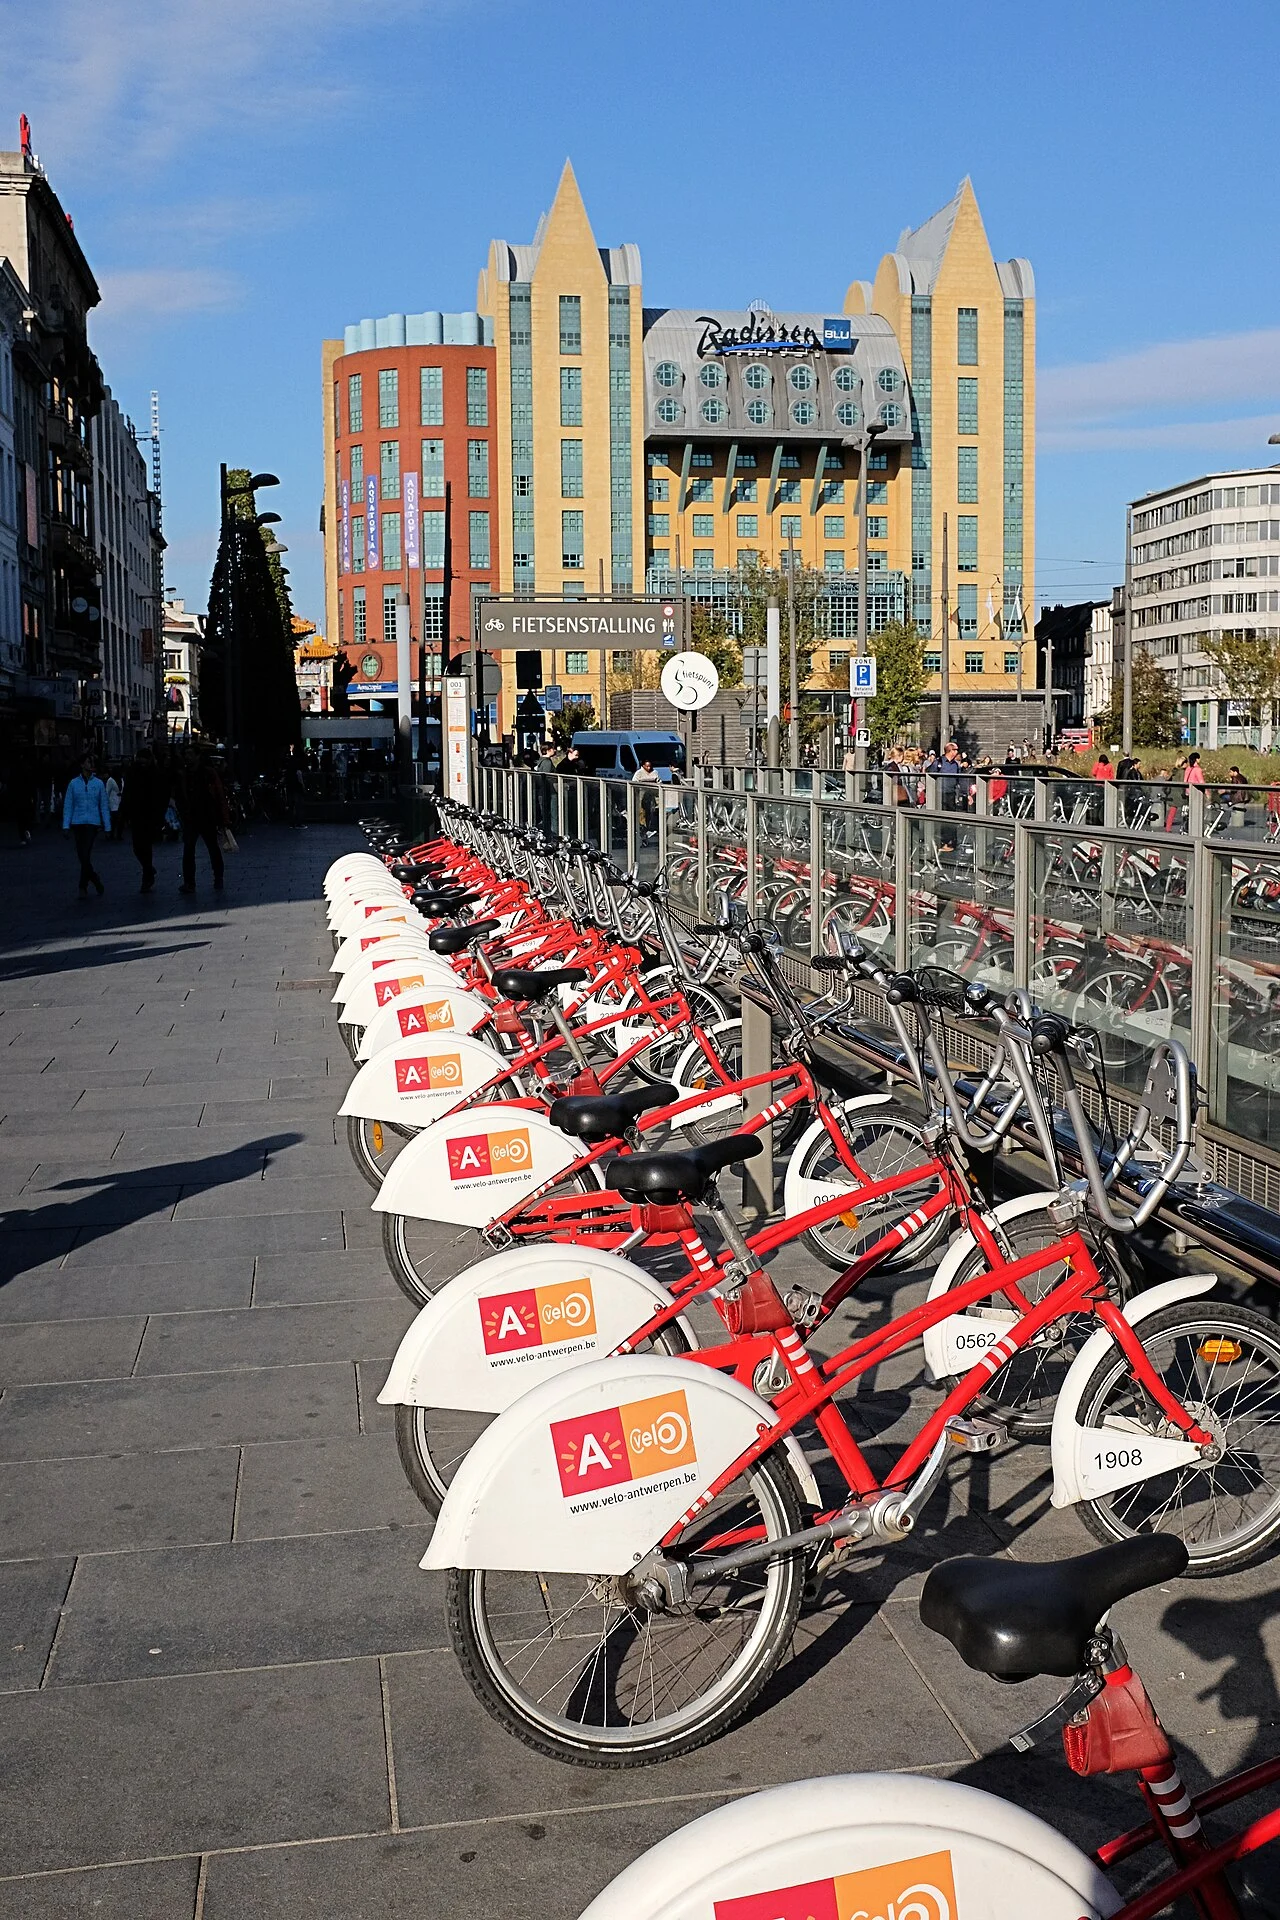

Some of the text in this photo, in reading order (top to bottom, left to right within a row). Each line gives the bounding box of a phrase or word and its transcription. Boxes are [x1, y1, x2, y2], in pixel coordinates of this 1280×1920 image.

[695, 311, 850, 359] Radisson BLU
[368, 480, 376, 549] AQUATOPIA
[407, 479, 415, 548] AQUATOPIA
[512, 616, 656, 634] FIETSENSTALLING
[682, 670, 714, 689] fietspunt
[407, 1013, 421, 1030] A
[405, 1065, 422, 1085] A
[430, 1061, 459, 1081] velo
[400, 1089, 462, 1101] www.velo-antwerpen.be
[460, 1145, 480, 1170] A
[492, 1138, 528, 1163] velo
[453, 1174, 532, 1191] www.velo-antwerpen.be
[542, 1292, 591, 1327] velo
[498, 1305, 527, 1340] A
[956, 1332, 997, 1350] 0562
[490, 1340, 596, 1368] www.velo-antwerpen.be
[630, 1411, 688, 1455] velo
[577, 1433, 613, 1477] A
[1094, 1448, 1143, 1470] 1908
[570, 1472, 697, 1515] www.velo-antwerpen.be
